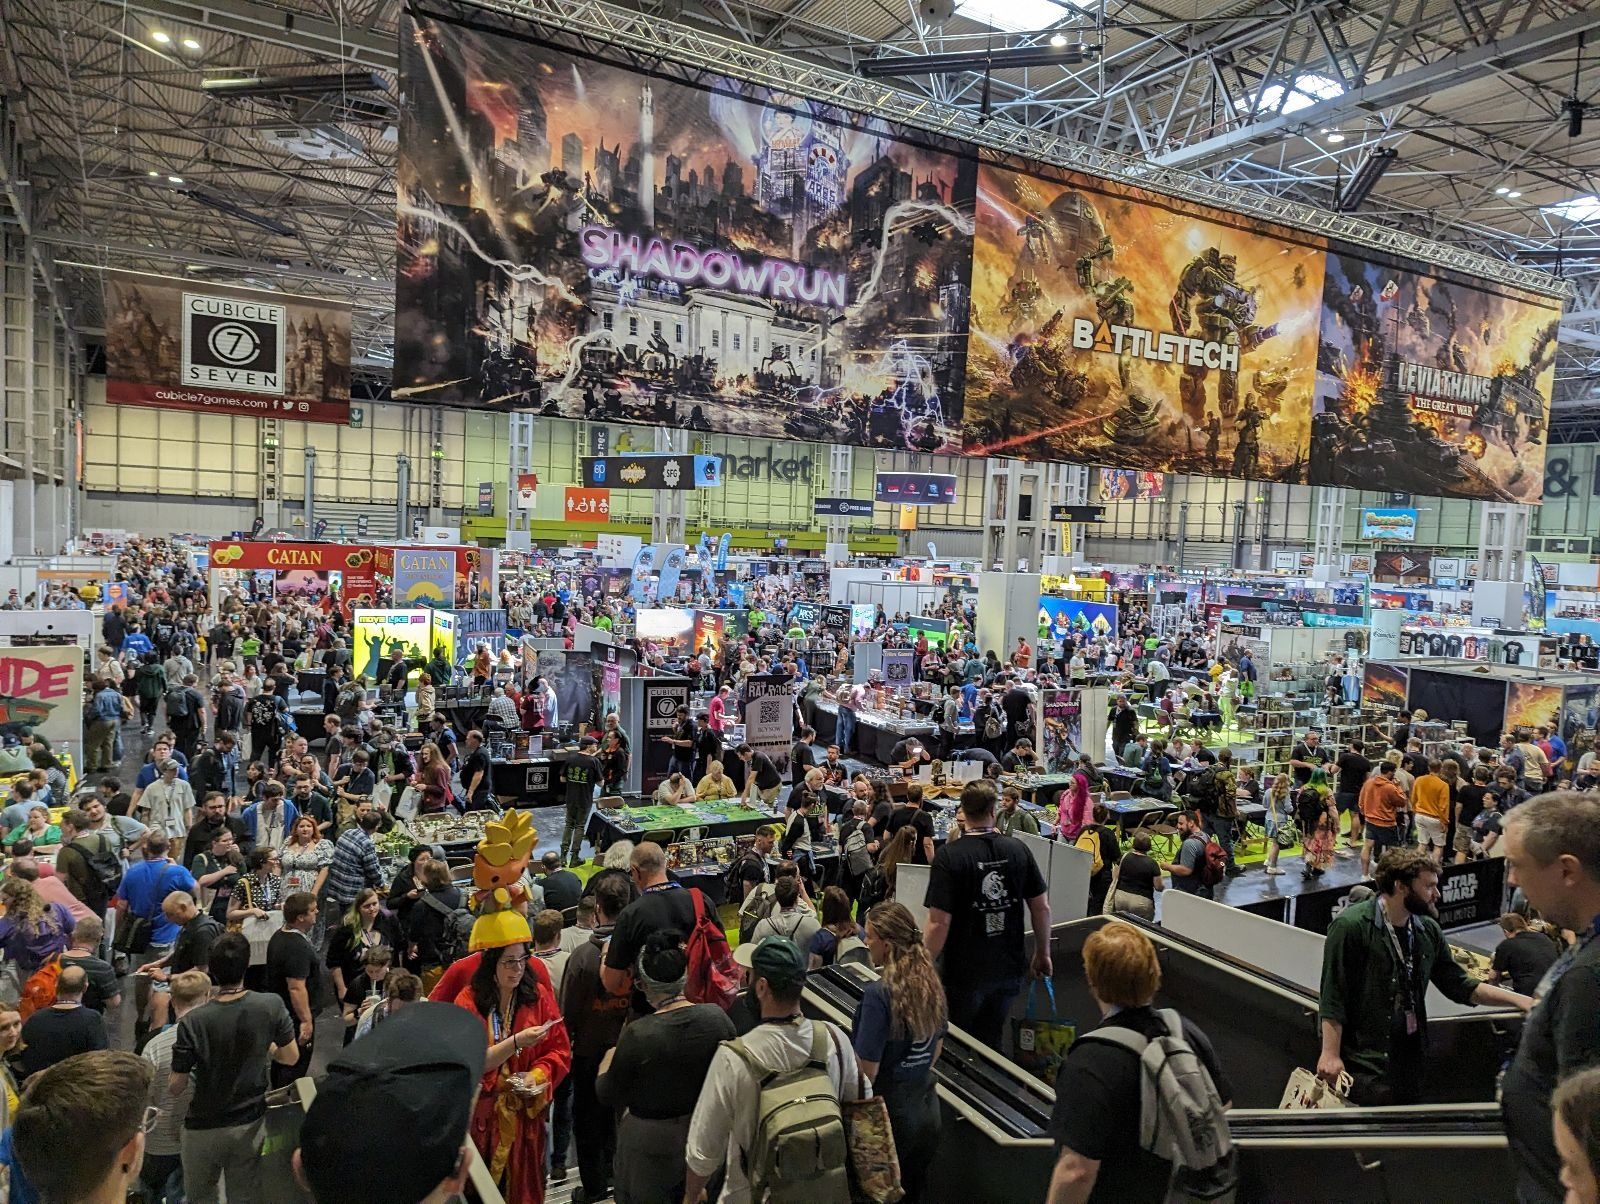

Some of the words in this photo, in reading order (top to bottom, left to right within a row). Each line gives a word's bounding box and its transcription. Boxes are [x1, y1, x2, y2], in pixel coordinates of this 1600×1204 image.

[582, 228, 846, 307] SHADOWRUN
[191, 299, 278, 321] CUBICLE
[226, 331, 243, 356] 7
[1073, 318, 1239, 373] BATTLETECH
[190, 366, 277, 388] SEVEN
[1398, 362, 1492, 405] LEVIATHANS
[155, 390, 268, 409] cubicle7games.com
[1416, 397, 1431, 410] THE
[1431, 401, 1454, 413] GREAT
[1456, 405, 1474, 417] WAR
[666, 468, 678, 478] SFG
[267, 548, 322, 565] CATAN
[400, 554, 449, 570] CATAN
[359, 616, 386, 624] MOVE
[388, 616, 408, 624] LIKE
[410, 616, 425, 624] ME
[0, 657, 74, 699] IDE
[650, 688, 684, 696] CUBICLE
[748, 685, 766, 697] RAT
[768, 684, 792, 696] RACE
[1443, 873, 1478, 890] STAR
[1442, 884, 1478, 903] WARS
